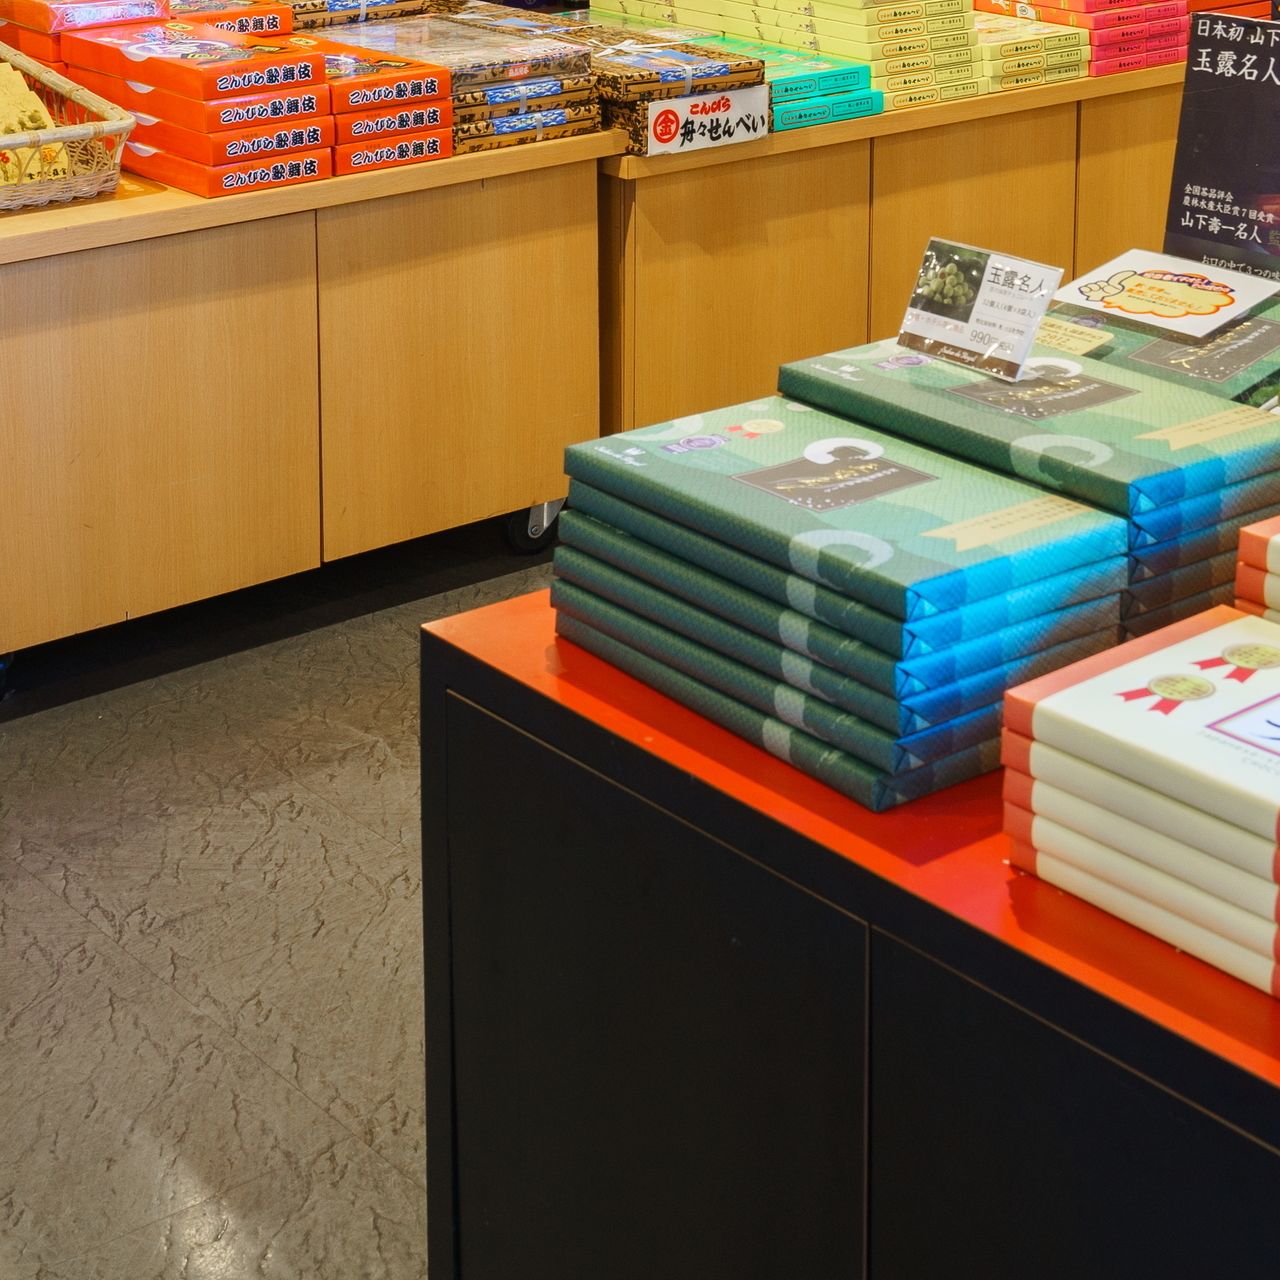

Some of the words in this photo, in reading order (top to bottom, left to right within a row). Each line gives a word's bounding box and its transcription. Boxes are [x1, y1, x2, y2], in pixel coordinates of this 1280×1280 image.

[1197, 19, 1245, 42] 日本初
[679, 114, 766, 147] 舟々せんべい
[986, 265, 1047, 299] 玉露名人
